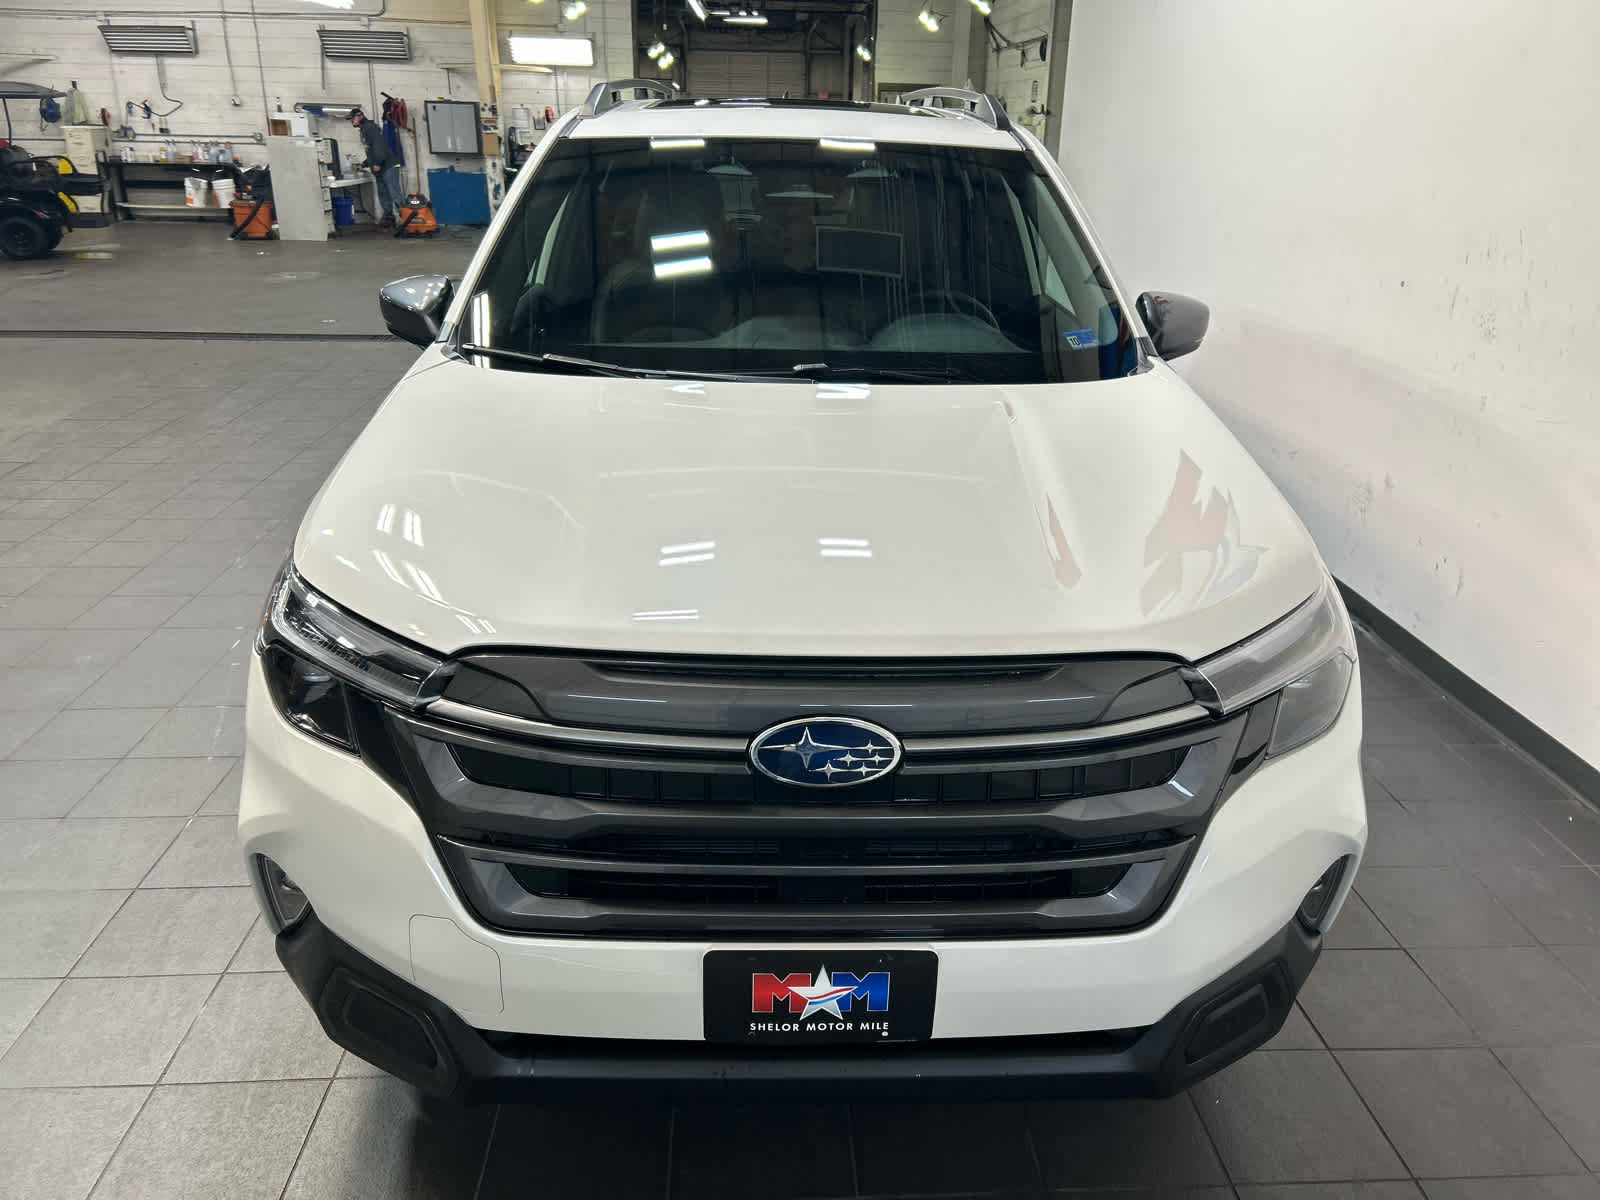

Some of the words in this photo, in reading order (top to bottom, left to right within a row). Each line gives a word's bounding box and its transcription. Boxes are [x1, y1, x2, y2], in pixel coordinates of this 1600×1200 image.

[750, 1023, 800, 1032] SHELOR
[806, 1022, 853, 1031] MOTOR
[860, 1022, 889, 1030] MILE
